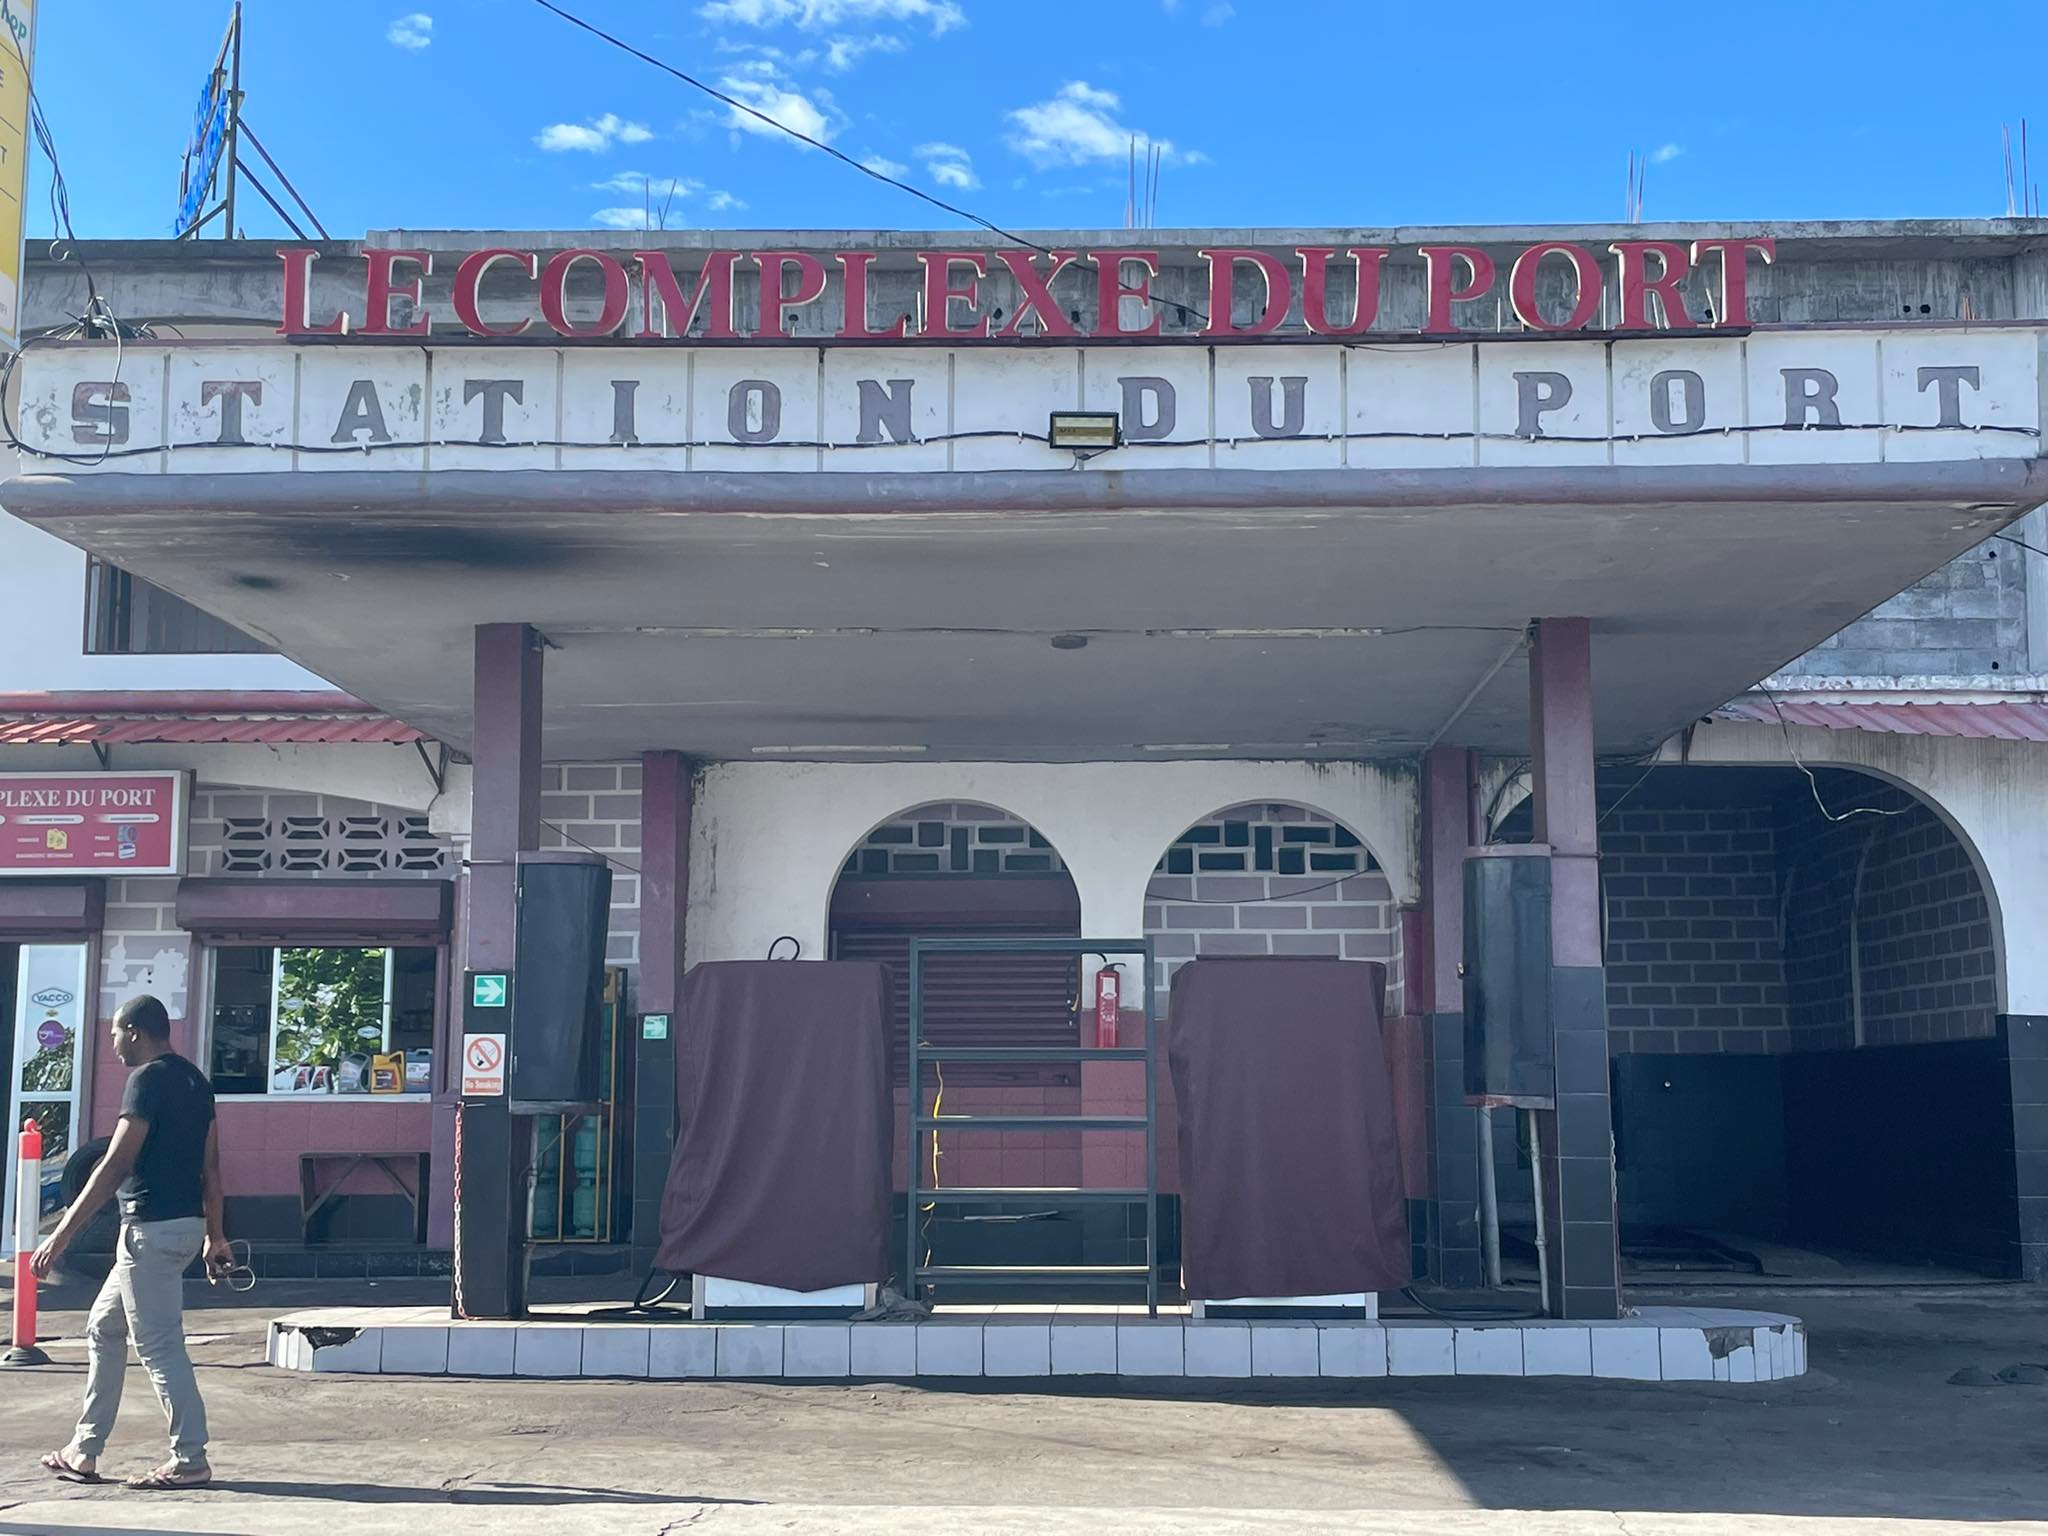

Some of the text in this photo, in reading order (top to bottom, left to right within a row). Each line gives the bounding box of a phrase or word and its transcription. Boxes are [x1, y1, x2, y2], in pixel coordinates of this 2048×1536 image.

[276, 239, 1776, 339] LE COMPLEXE DU PORT
[71, 366, 1980, 444] STATION DU PORT
[66, 789, 95, 807] DU
[100, 788, 156, 807] PORT
[37, 994, 70, 1002] YACCO
